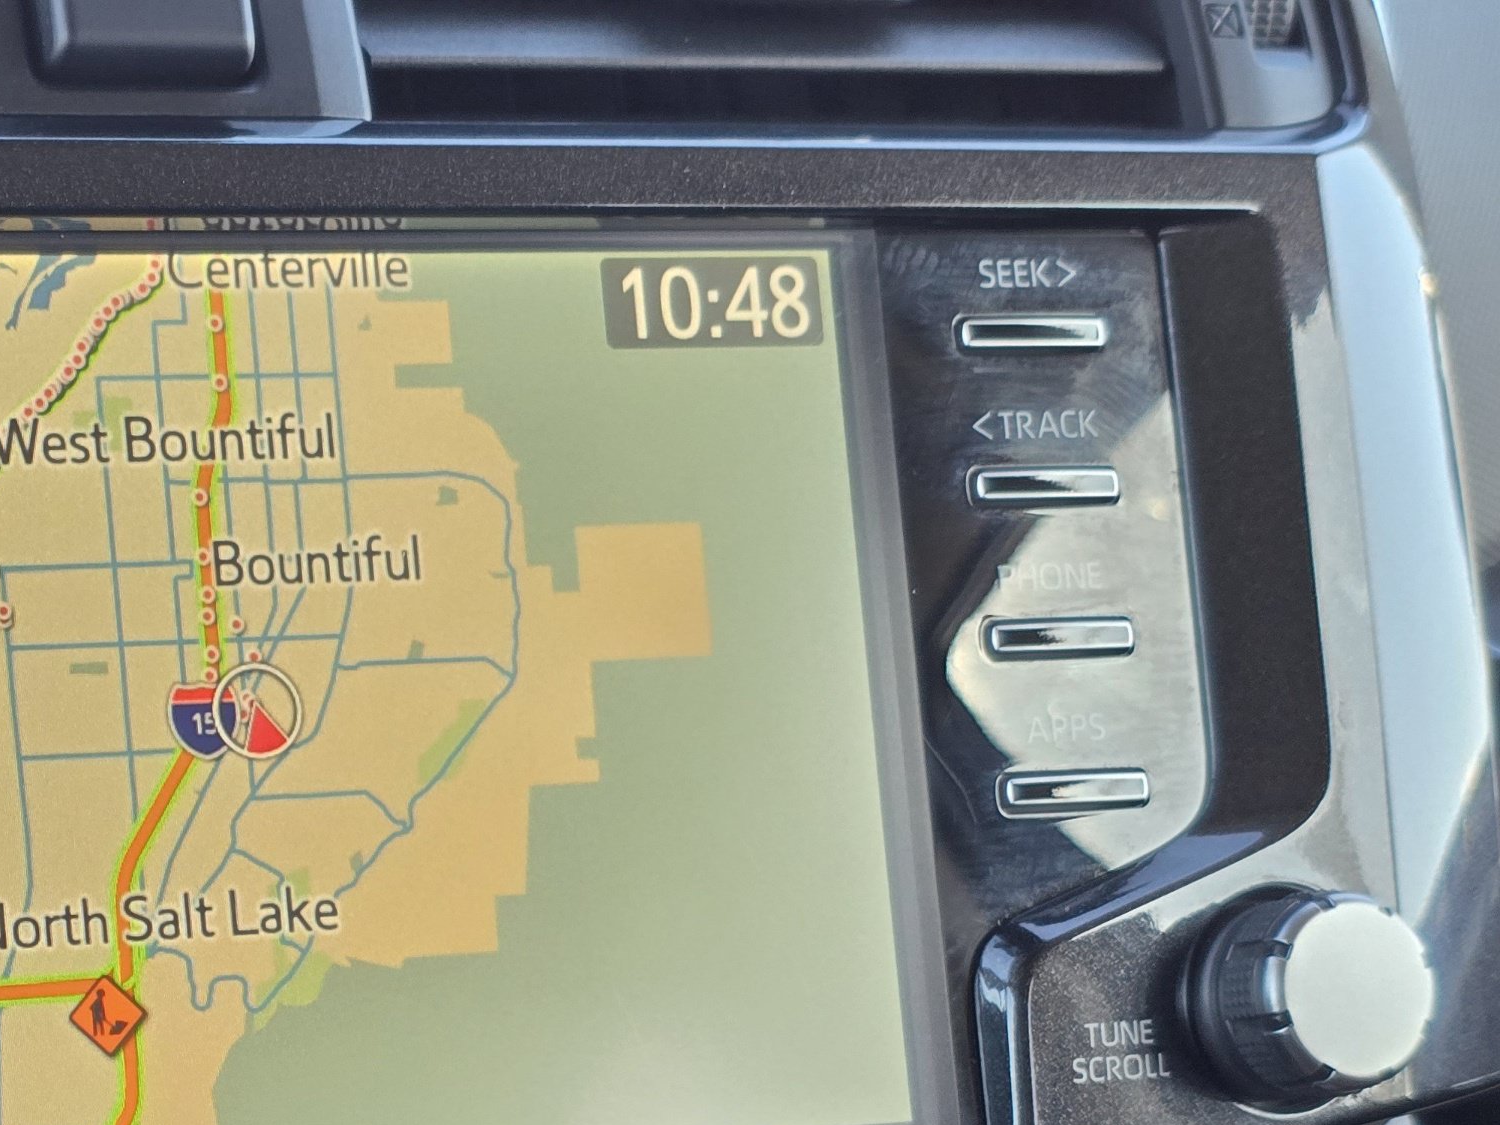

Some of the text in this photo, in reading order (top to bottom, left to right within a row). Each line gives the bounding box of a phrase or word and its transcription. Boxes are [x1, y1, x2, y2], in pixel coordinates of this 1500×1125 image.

[167, 250, 408, 289] Centerville
[621, 265, 811, 341] 10:48
[125, 413, 338, 463] Bountiful
[213, 535, 422, 587] Bountiful
[997, 562, 1104, 590] PHONE
[191, 712, 219, 735] 15
[1028, 713, 1107, 744] APPS
[124, 893, 215, 942] Salt
[228, 886, 339, 936] Lake
[1084, 1019, 1154, 1048] TUNE
[1072, 1053, 1171, 1084] SCROLL
